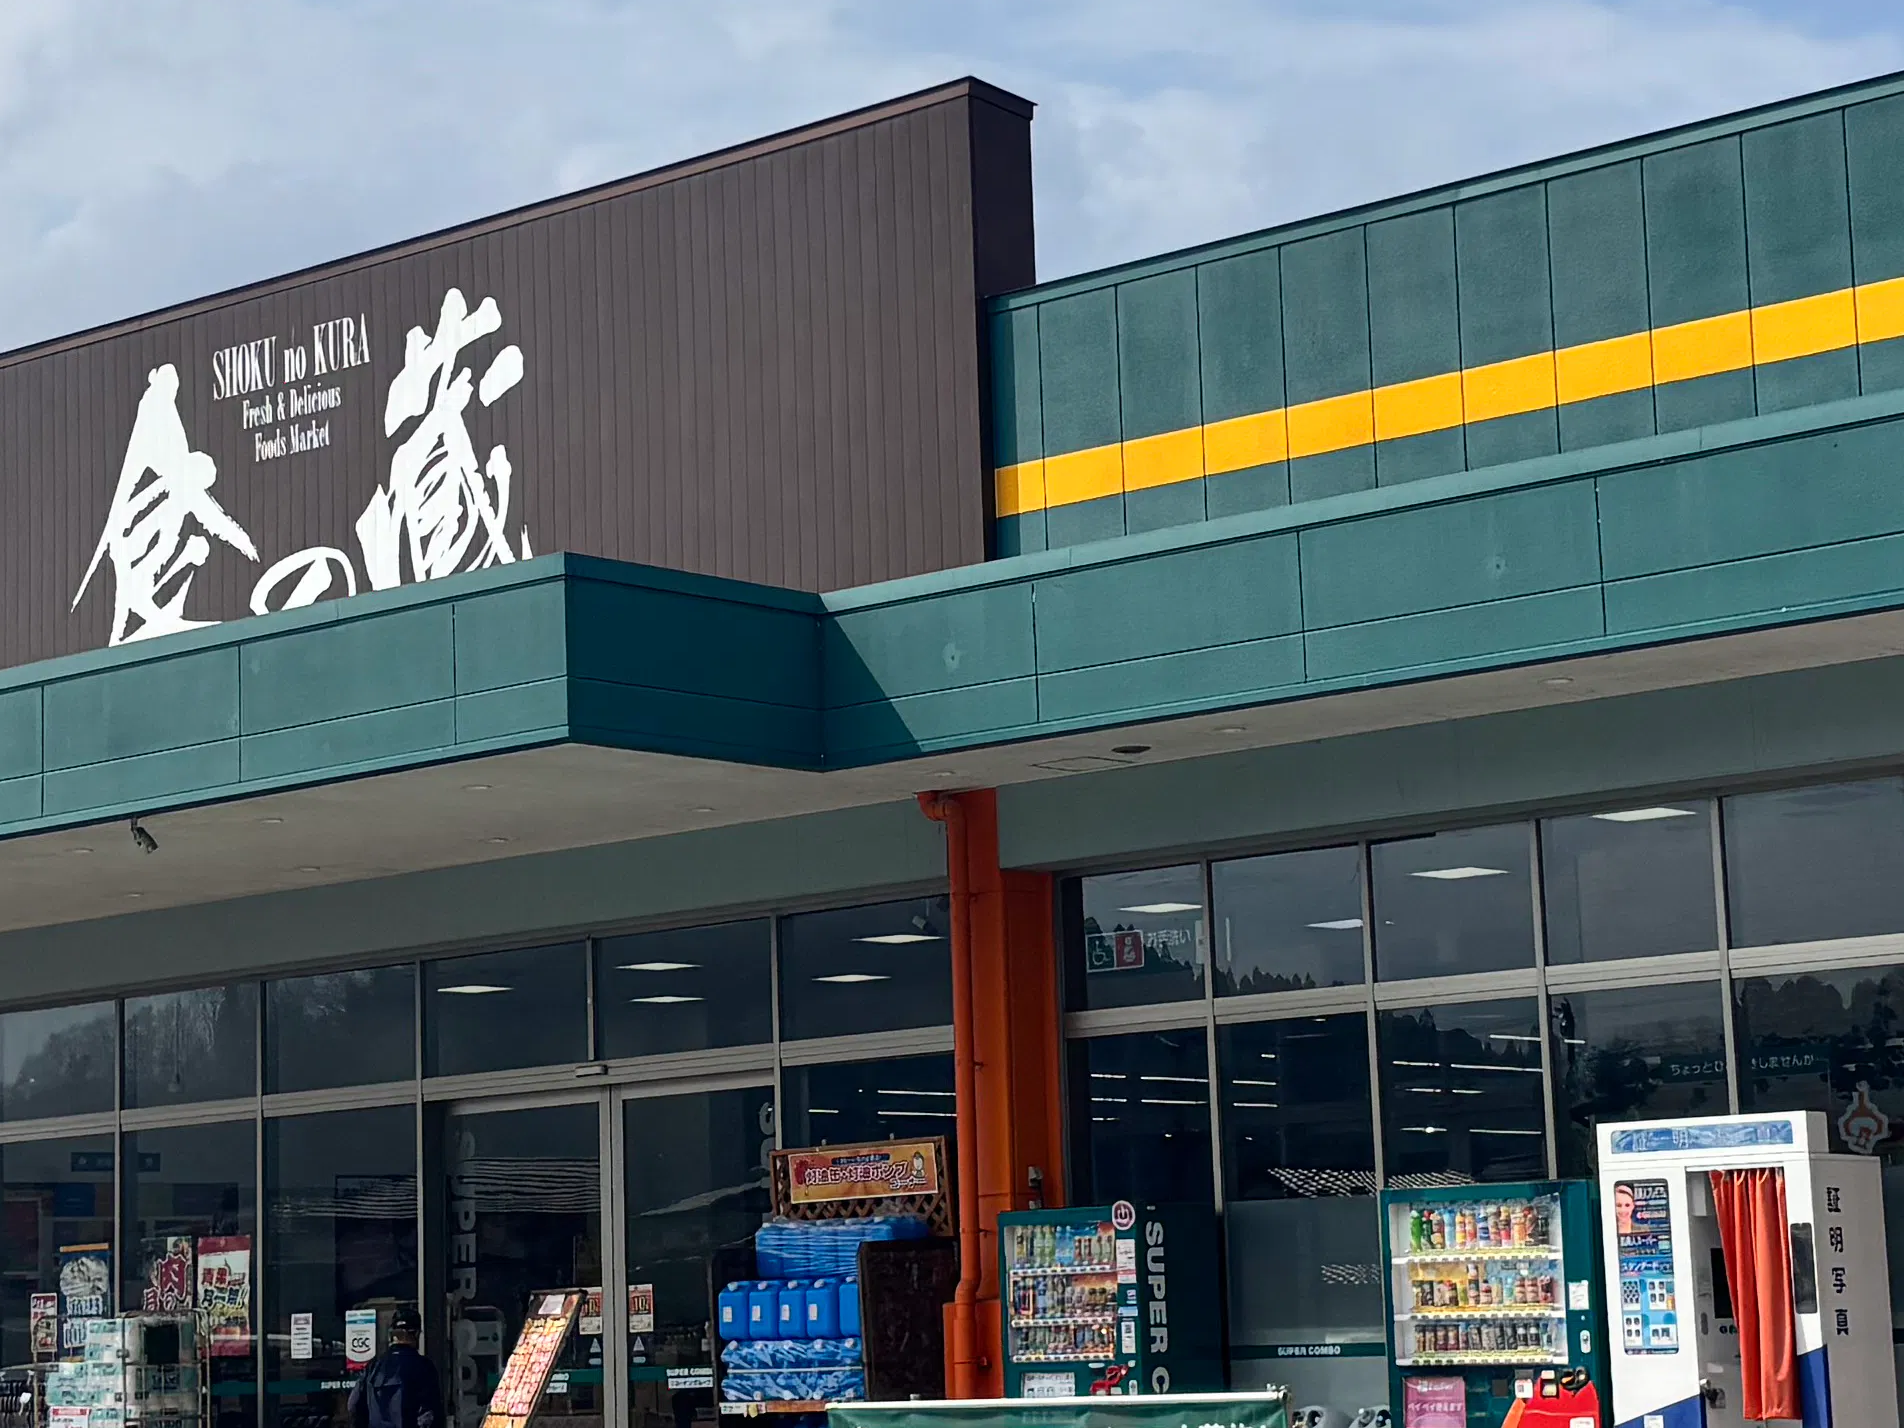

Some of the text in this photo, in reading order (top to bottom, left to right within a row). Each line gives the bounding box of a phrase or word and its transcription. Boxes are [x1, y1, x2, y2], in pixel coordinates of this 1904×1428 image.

[212, 312, 371, 401] SHOKU no KURA
[242, 382, 342, 430] Fresh & Delicious
[254, 419, 331, 463] Foods Market
[1145, 1220, 1168, 1353] SUPER
[351, 1337, 371, 1349] CGC
[1277, 1346, 1307, 1356] SUPER
